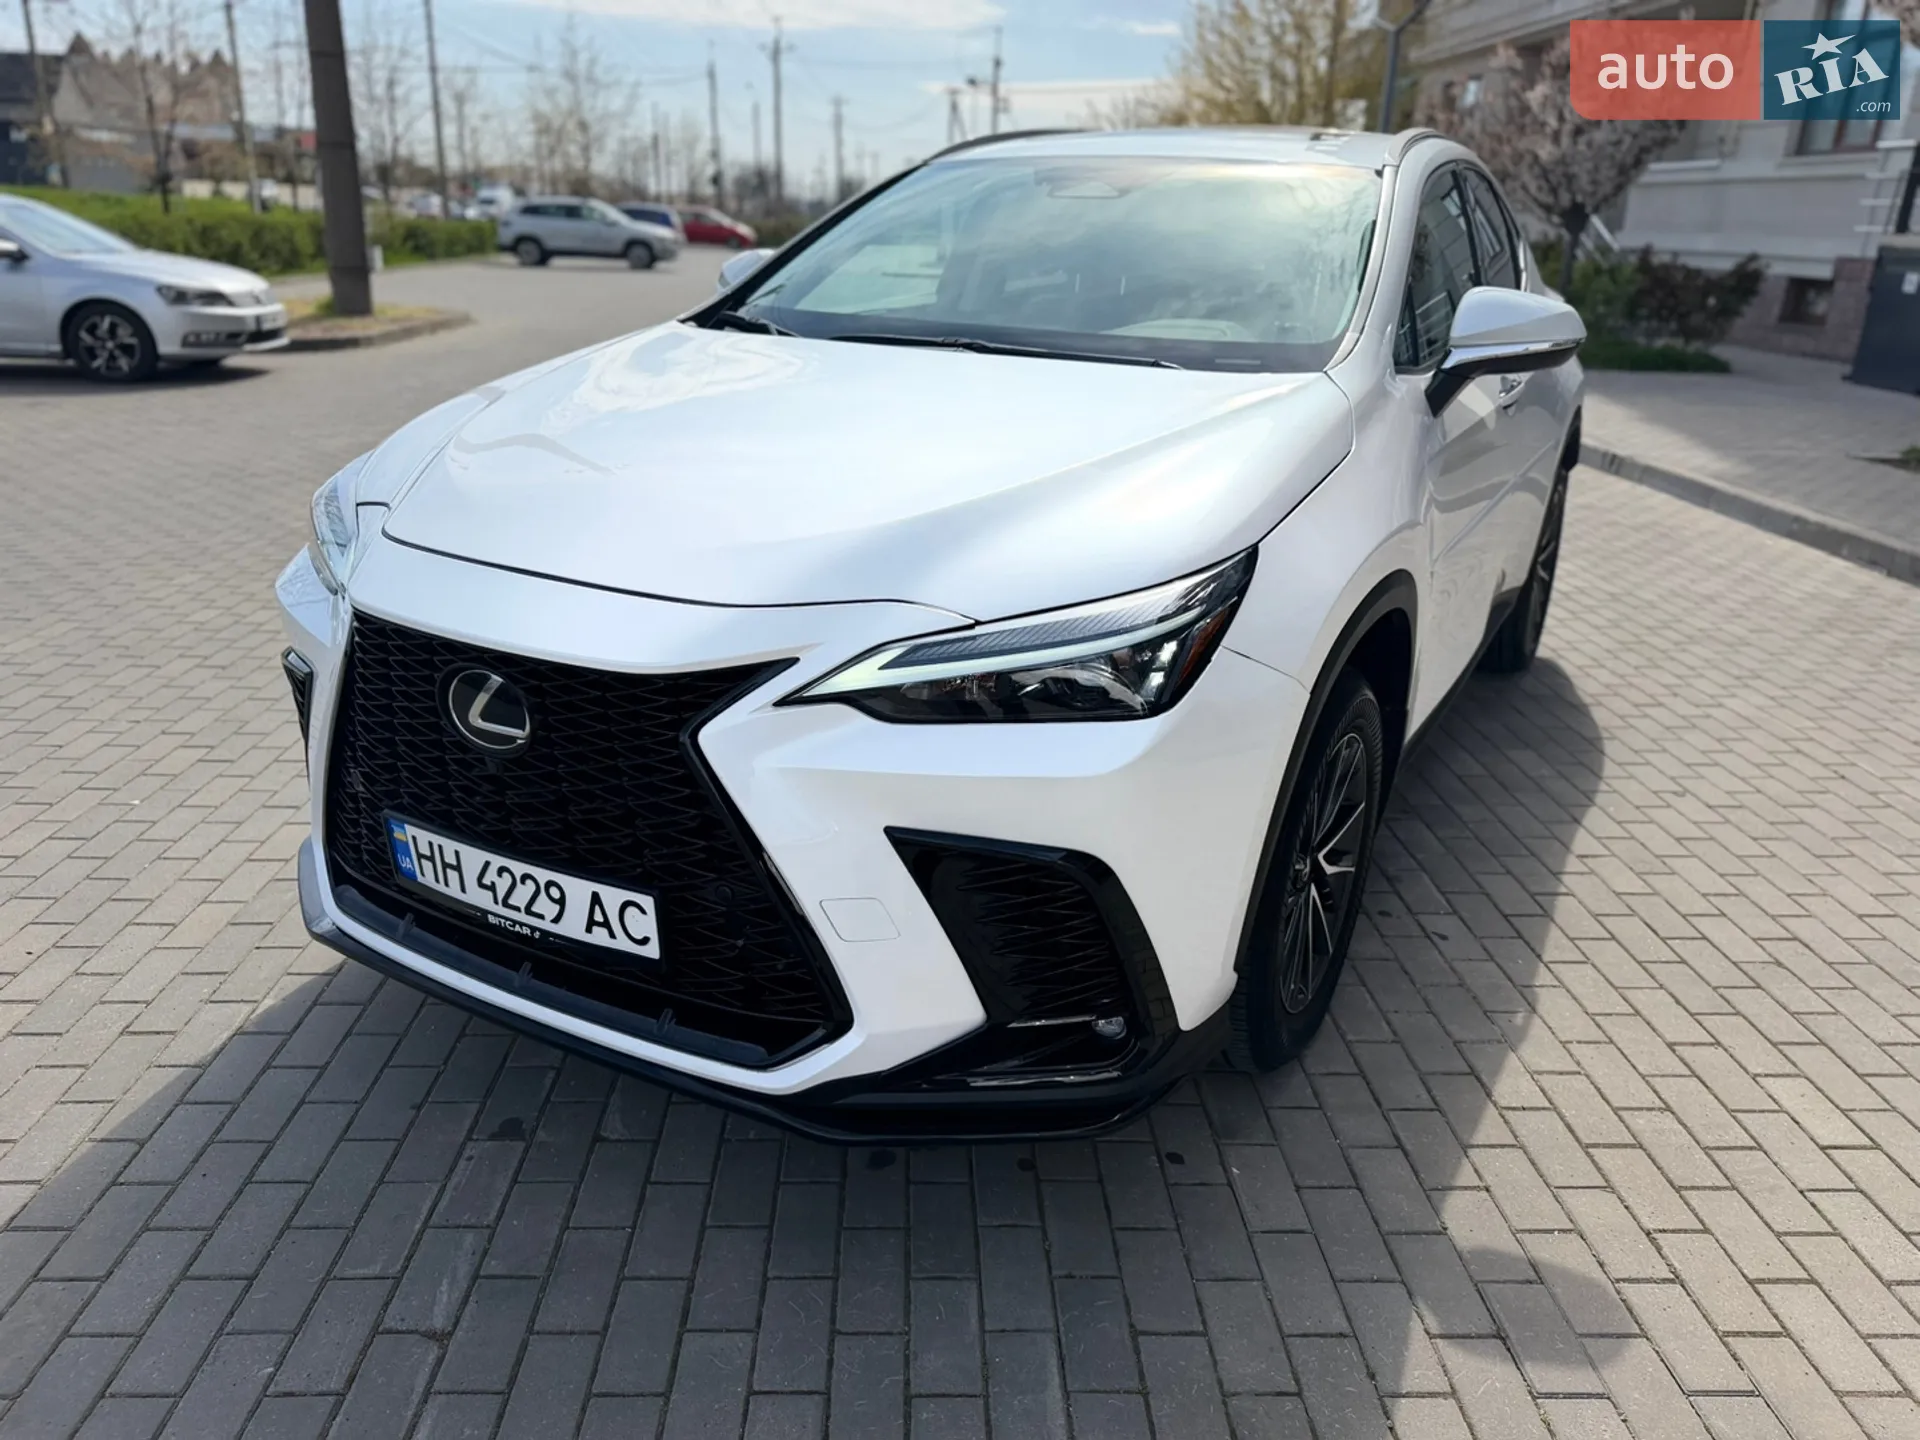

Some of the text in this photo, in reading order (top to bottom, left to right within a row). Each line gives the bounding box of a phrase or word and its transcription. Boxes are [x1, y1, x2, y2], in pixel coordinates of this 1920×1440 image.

[397, 853, 415, 871] UA
[411, 834, 652, 947] HH 4229 AC
[487, 913, 532, 937] BITCAR
